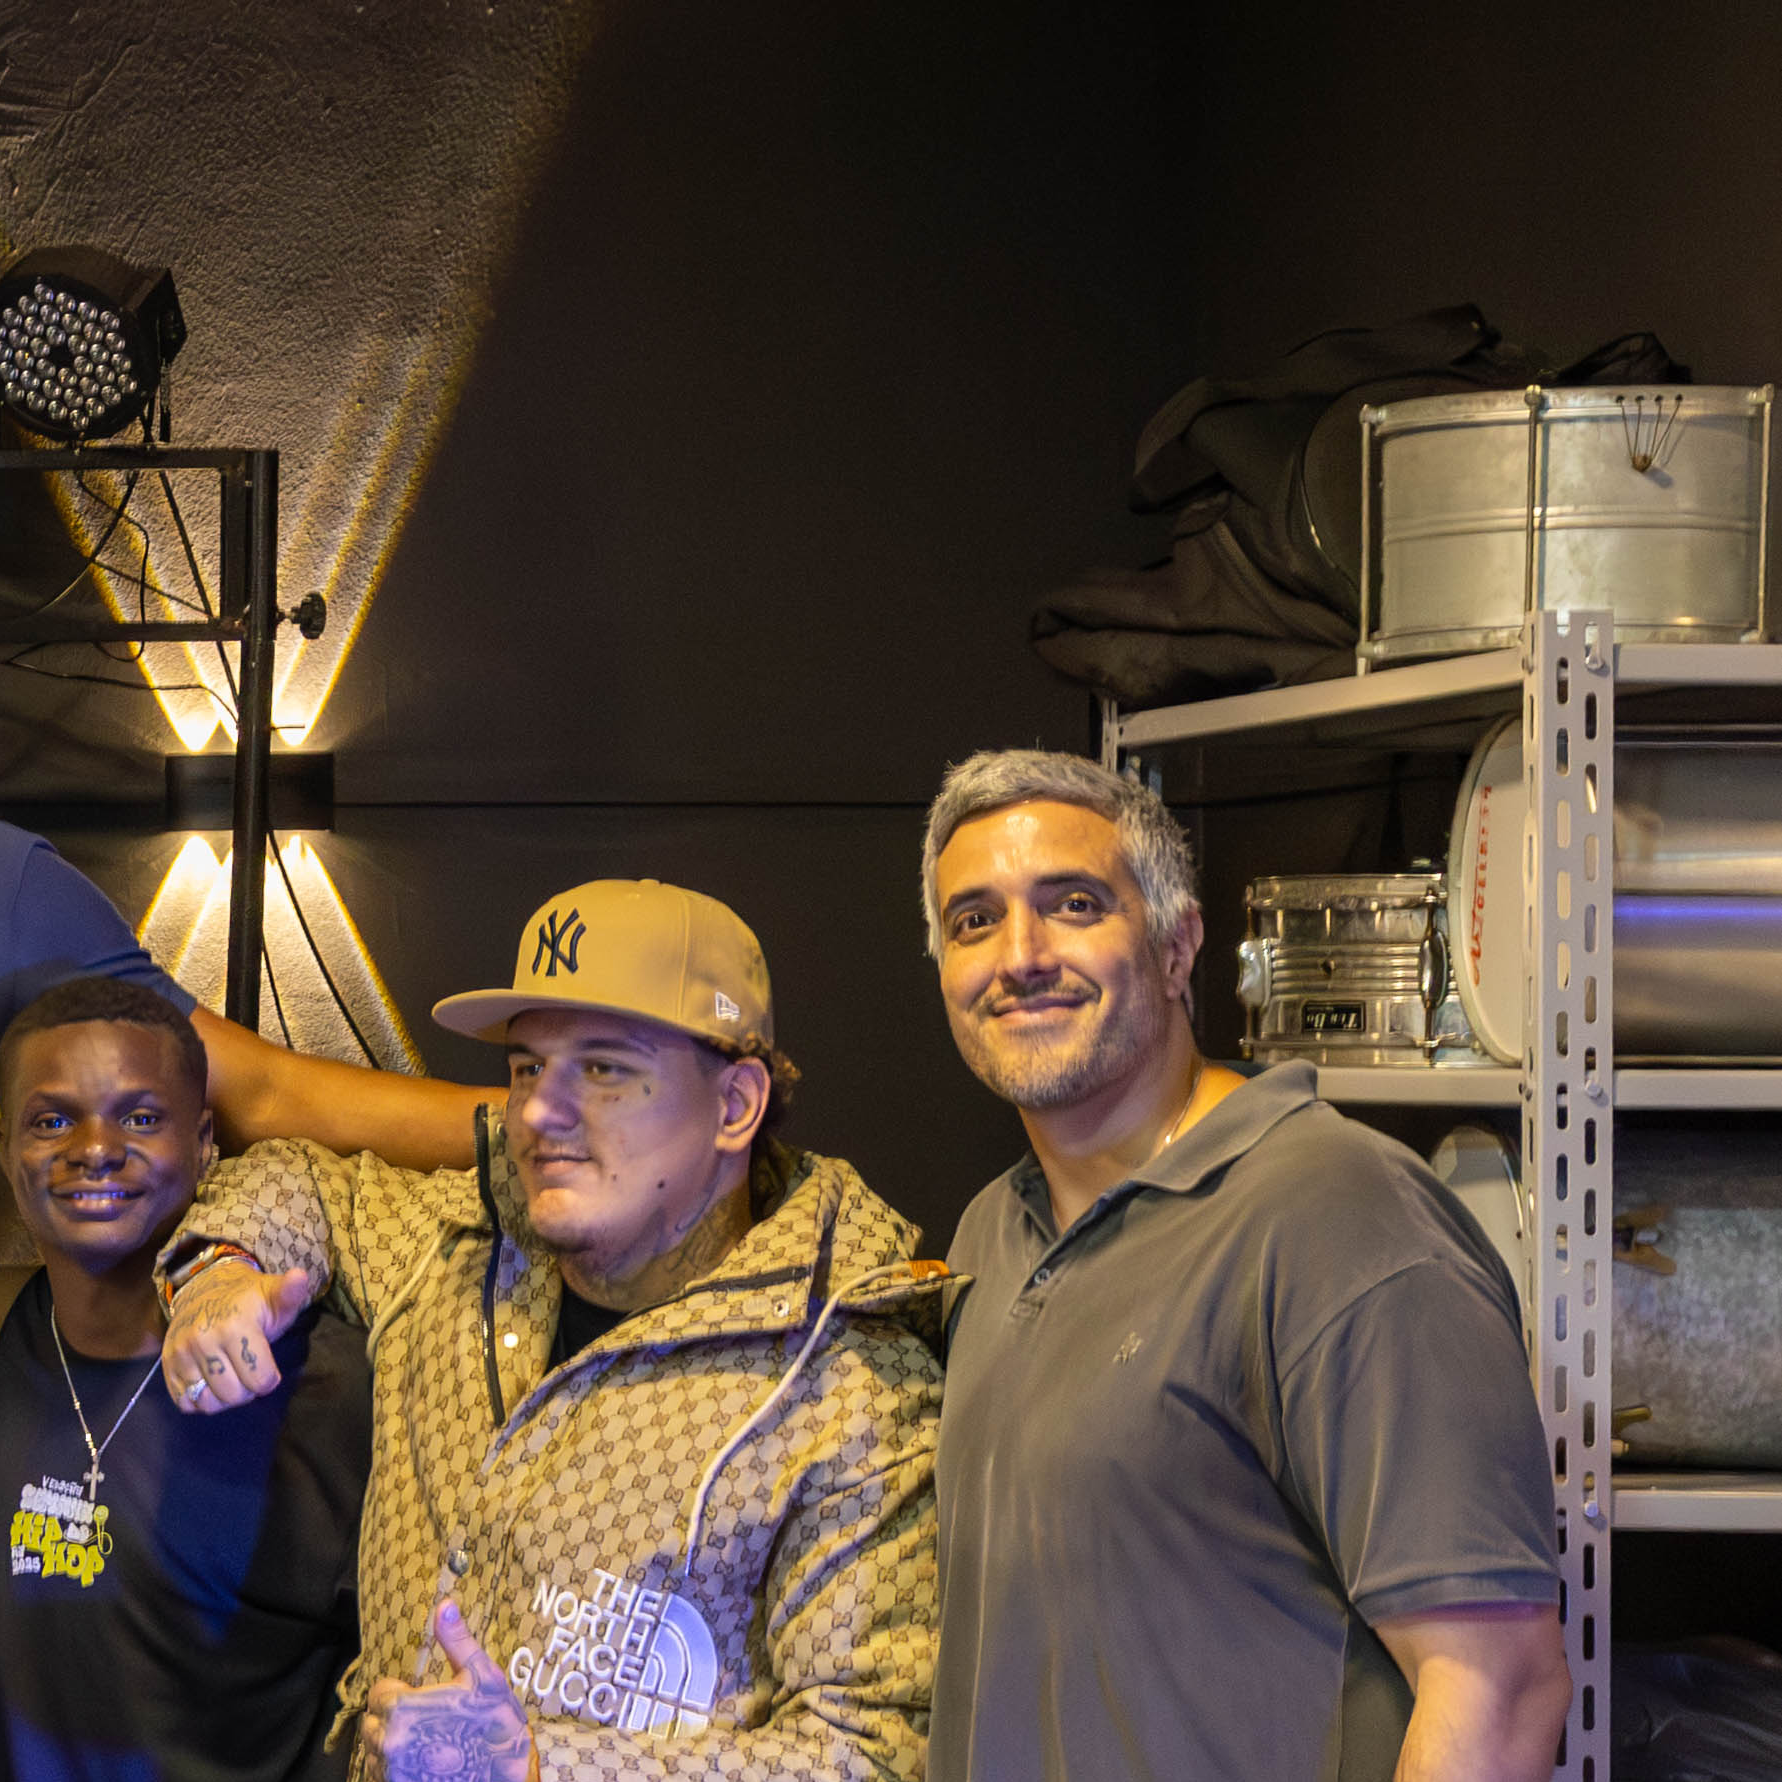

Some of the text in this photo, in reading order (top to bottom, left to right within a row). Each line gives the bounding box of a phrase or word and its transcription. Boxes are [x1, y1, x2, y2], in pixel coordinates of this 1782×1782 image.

[42, 1541, 105, 1588] HOP
[593, 1568, 664, 1620] THE
[532, 1579, 651, 1656] NORTH
[510, 1646, 632, 1729] GUCCI
[546, 1626, 646, 1690] FACE
